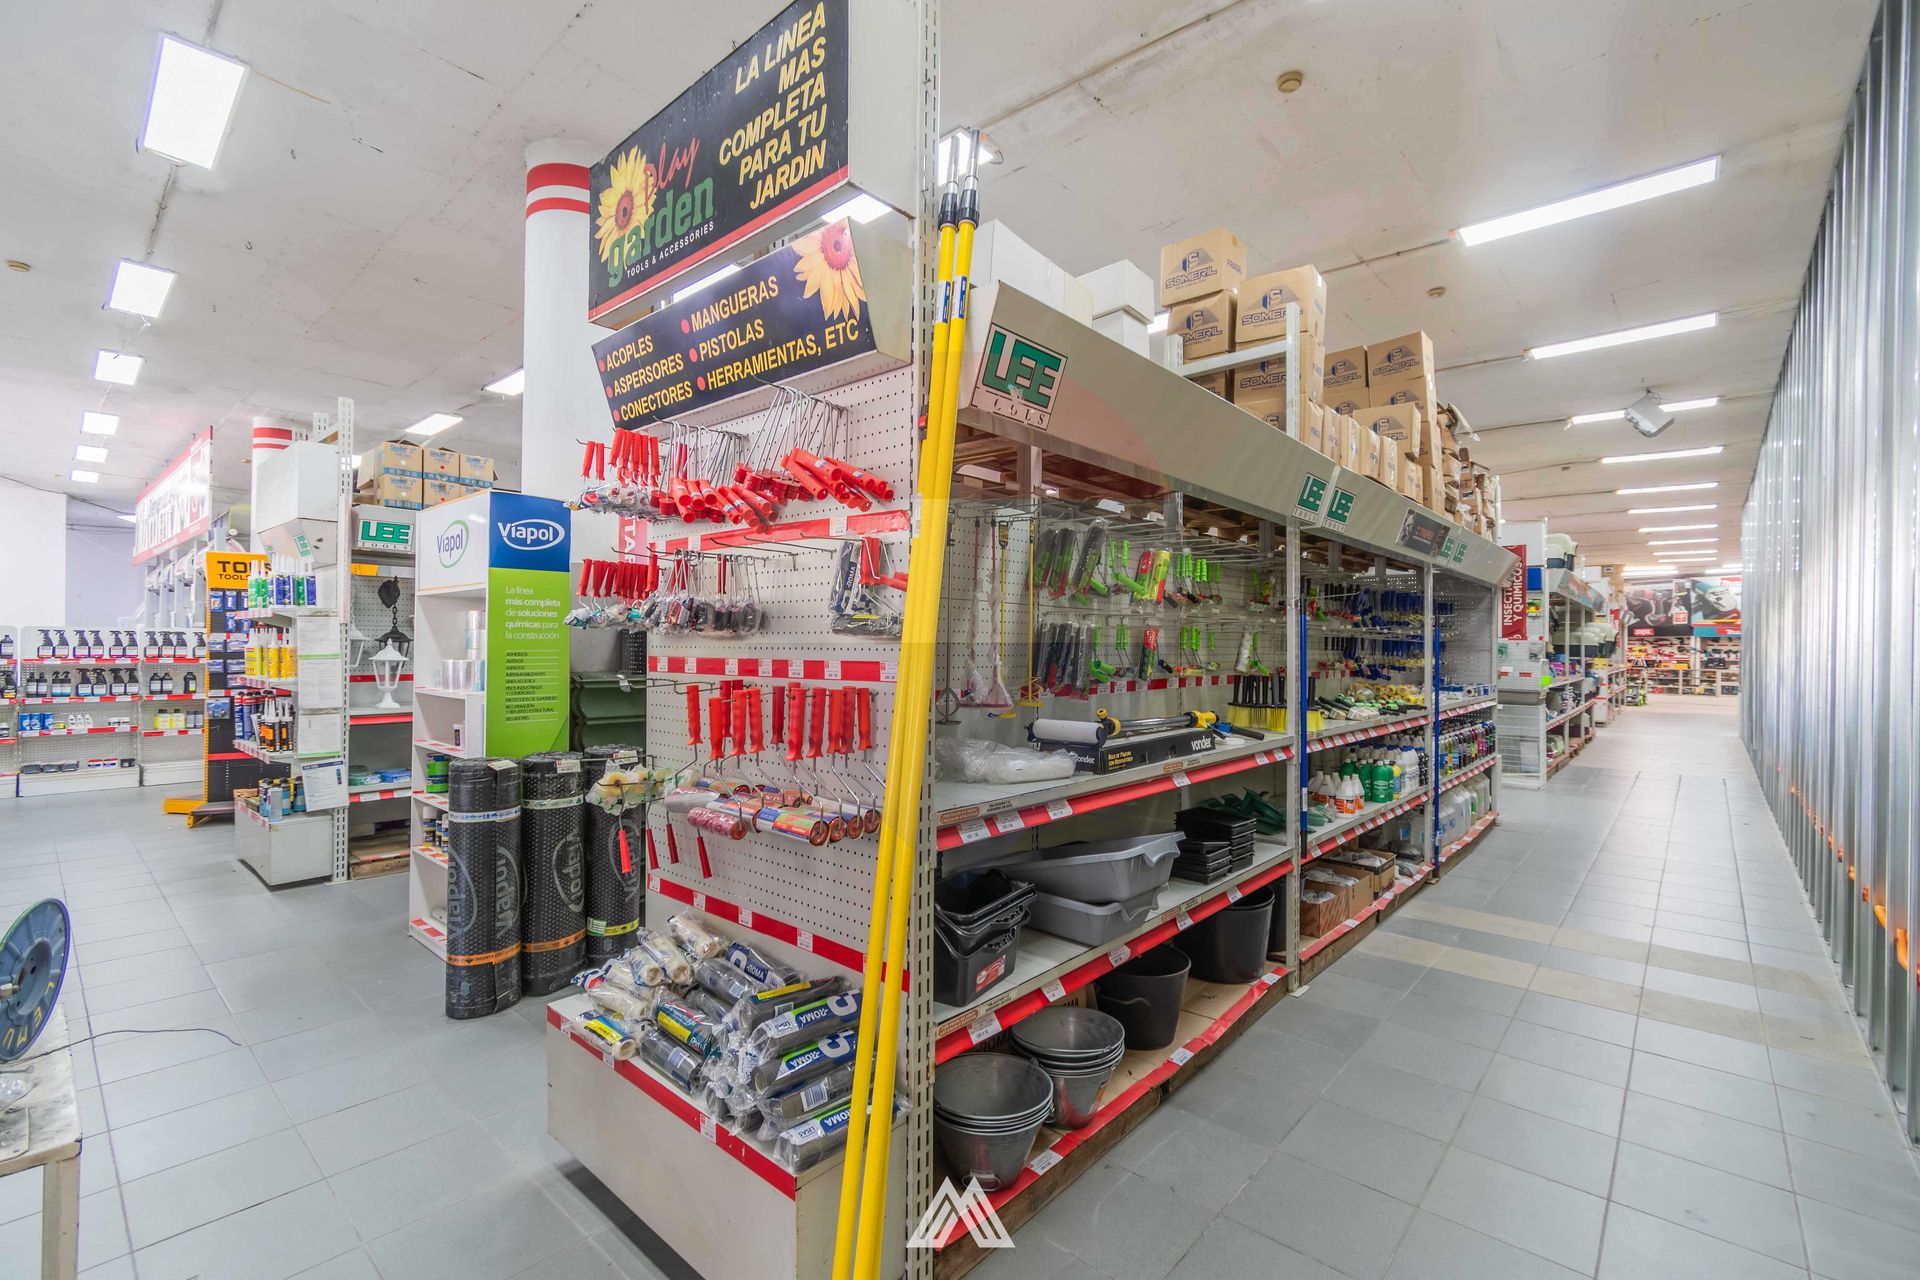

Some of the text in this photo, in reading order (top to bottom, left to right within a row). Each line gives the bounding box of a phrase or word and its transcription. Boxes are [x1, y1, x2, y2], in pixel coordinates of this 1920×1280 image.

[735, 2, 826, 95] LA LINEA
[778, 36, 826, 94] MAS
[719, 71, 826, 166] COMPLETA
[739, 103, 827, 186] PARA TU
[750, 139, 826, 210] JARDIN
[608, 177, 714, 288] garden
[626, 221, 714, 279] TOOLS & ACCESSORIES
[1166, 266, 1218, 290] SOMERIL
[691, 276, 779, 332] MANGUERAS
[606, 335, 654, 371] ACOPLES
[699, 319, 765, 362] PISTOLAS
[708, 319, 859, 391] HERRAMIENTAS, ETC
[1182, 326, 1223, 344] OMERIL
[613, 353, 684, 397] ASPERSORES
[982, 330, 1062, 409] LEE
[620, 380, 693, 421] CONECTORES
[361, 520, 411, 544] LEE
[362, 542, 409, 551] TOOLS
[437, 528, 463, 559] Viapol
[497, 522, 554, 545] Viapol
[518, 609, 558, 618] soluciones
[524, 599, 560, 608] completa
[799, 1008, 828, 1024] ROMA
[790, 1050, 820, 1069] ROMA
